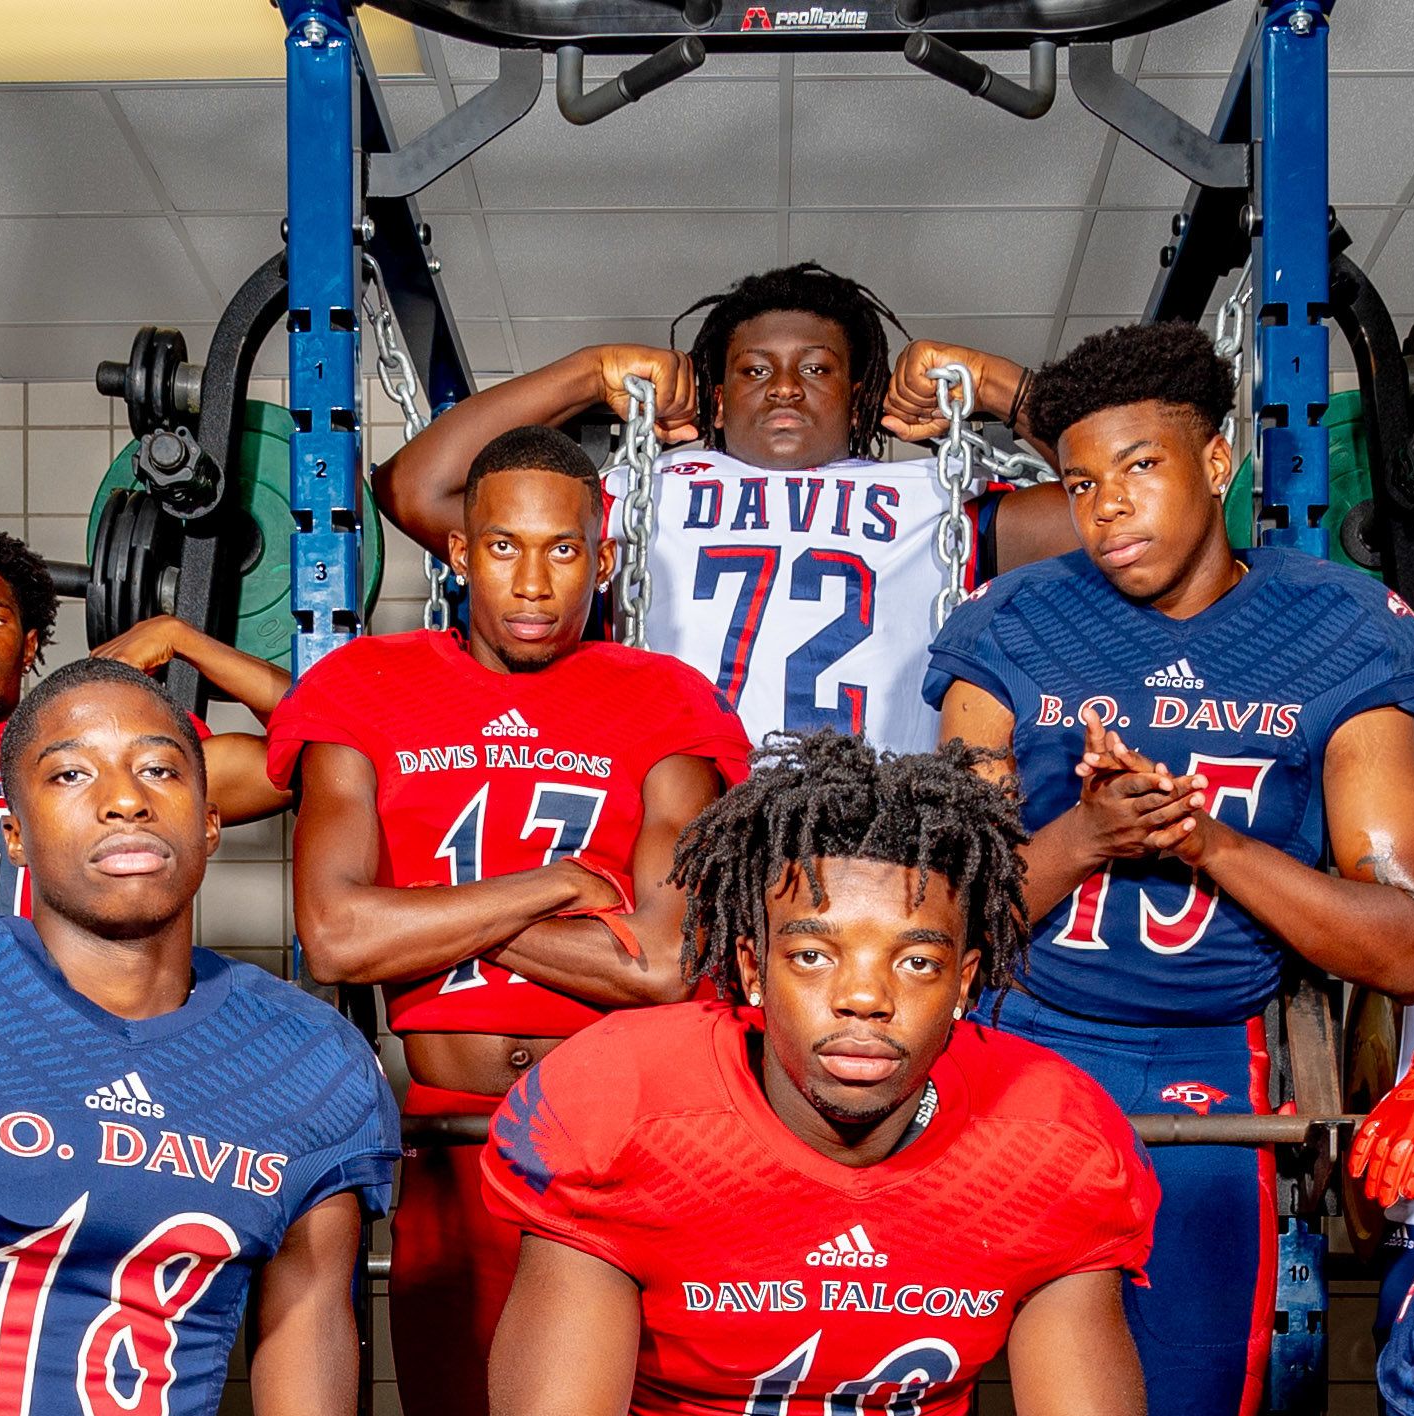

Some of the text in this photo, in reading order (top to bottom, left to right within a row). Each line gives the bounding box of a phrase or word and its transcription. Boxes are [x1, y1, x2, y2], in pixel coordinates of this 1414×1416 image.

[313, 363, 325, 380] 1
[1290, 356, 1301, 374] 1
[315, 461, 328, 479] 2
[1291, 455, 1304, 474] 2
[683, 476, 900, 544] DAVIS
[314, 560, 328, 581] 3
[692, 544, 877, 736] 72
[1143, 674, 1205, 690] adidas
[1036, 693, 1303, 739] B.O. DAVIS
[481, 722, 539, 738] adidas
[395, 744, 613, 778] DAVIS FALCONS
[84, 1094, 166, 1120] adidas
[97, 1120, 289, 1197] DAVIS
[805, 1249, 889, 1268] adidas
[1288, 1264, 1311, 1283] 10
[681, 1280, 1004, 1320] DAVIS FALCONS
